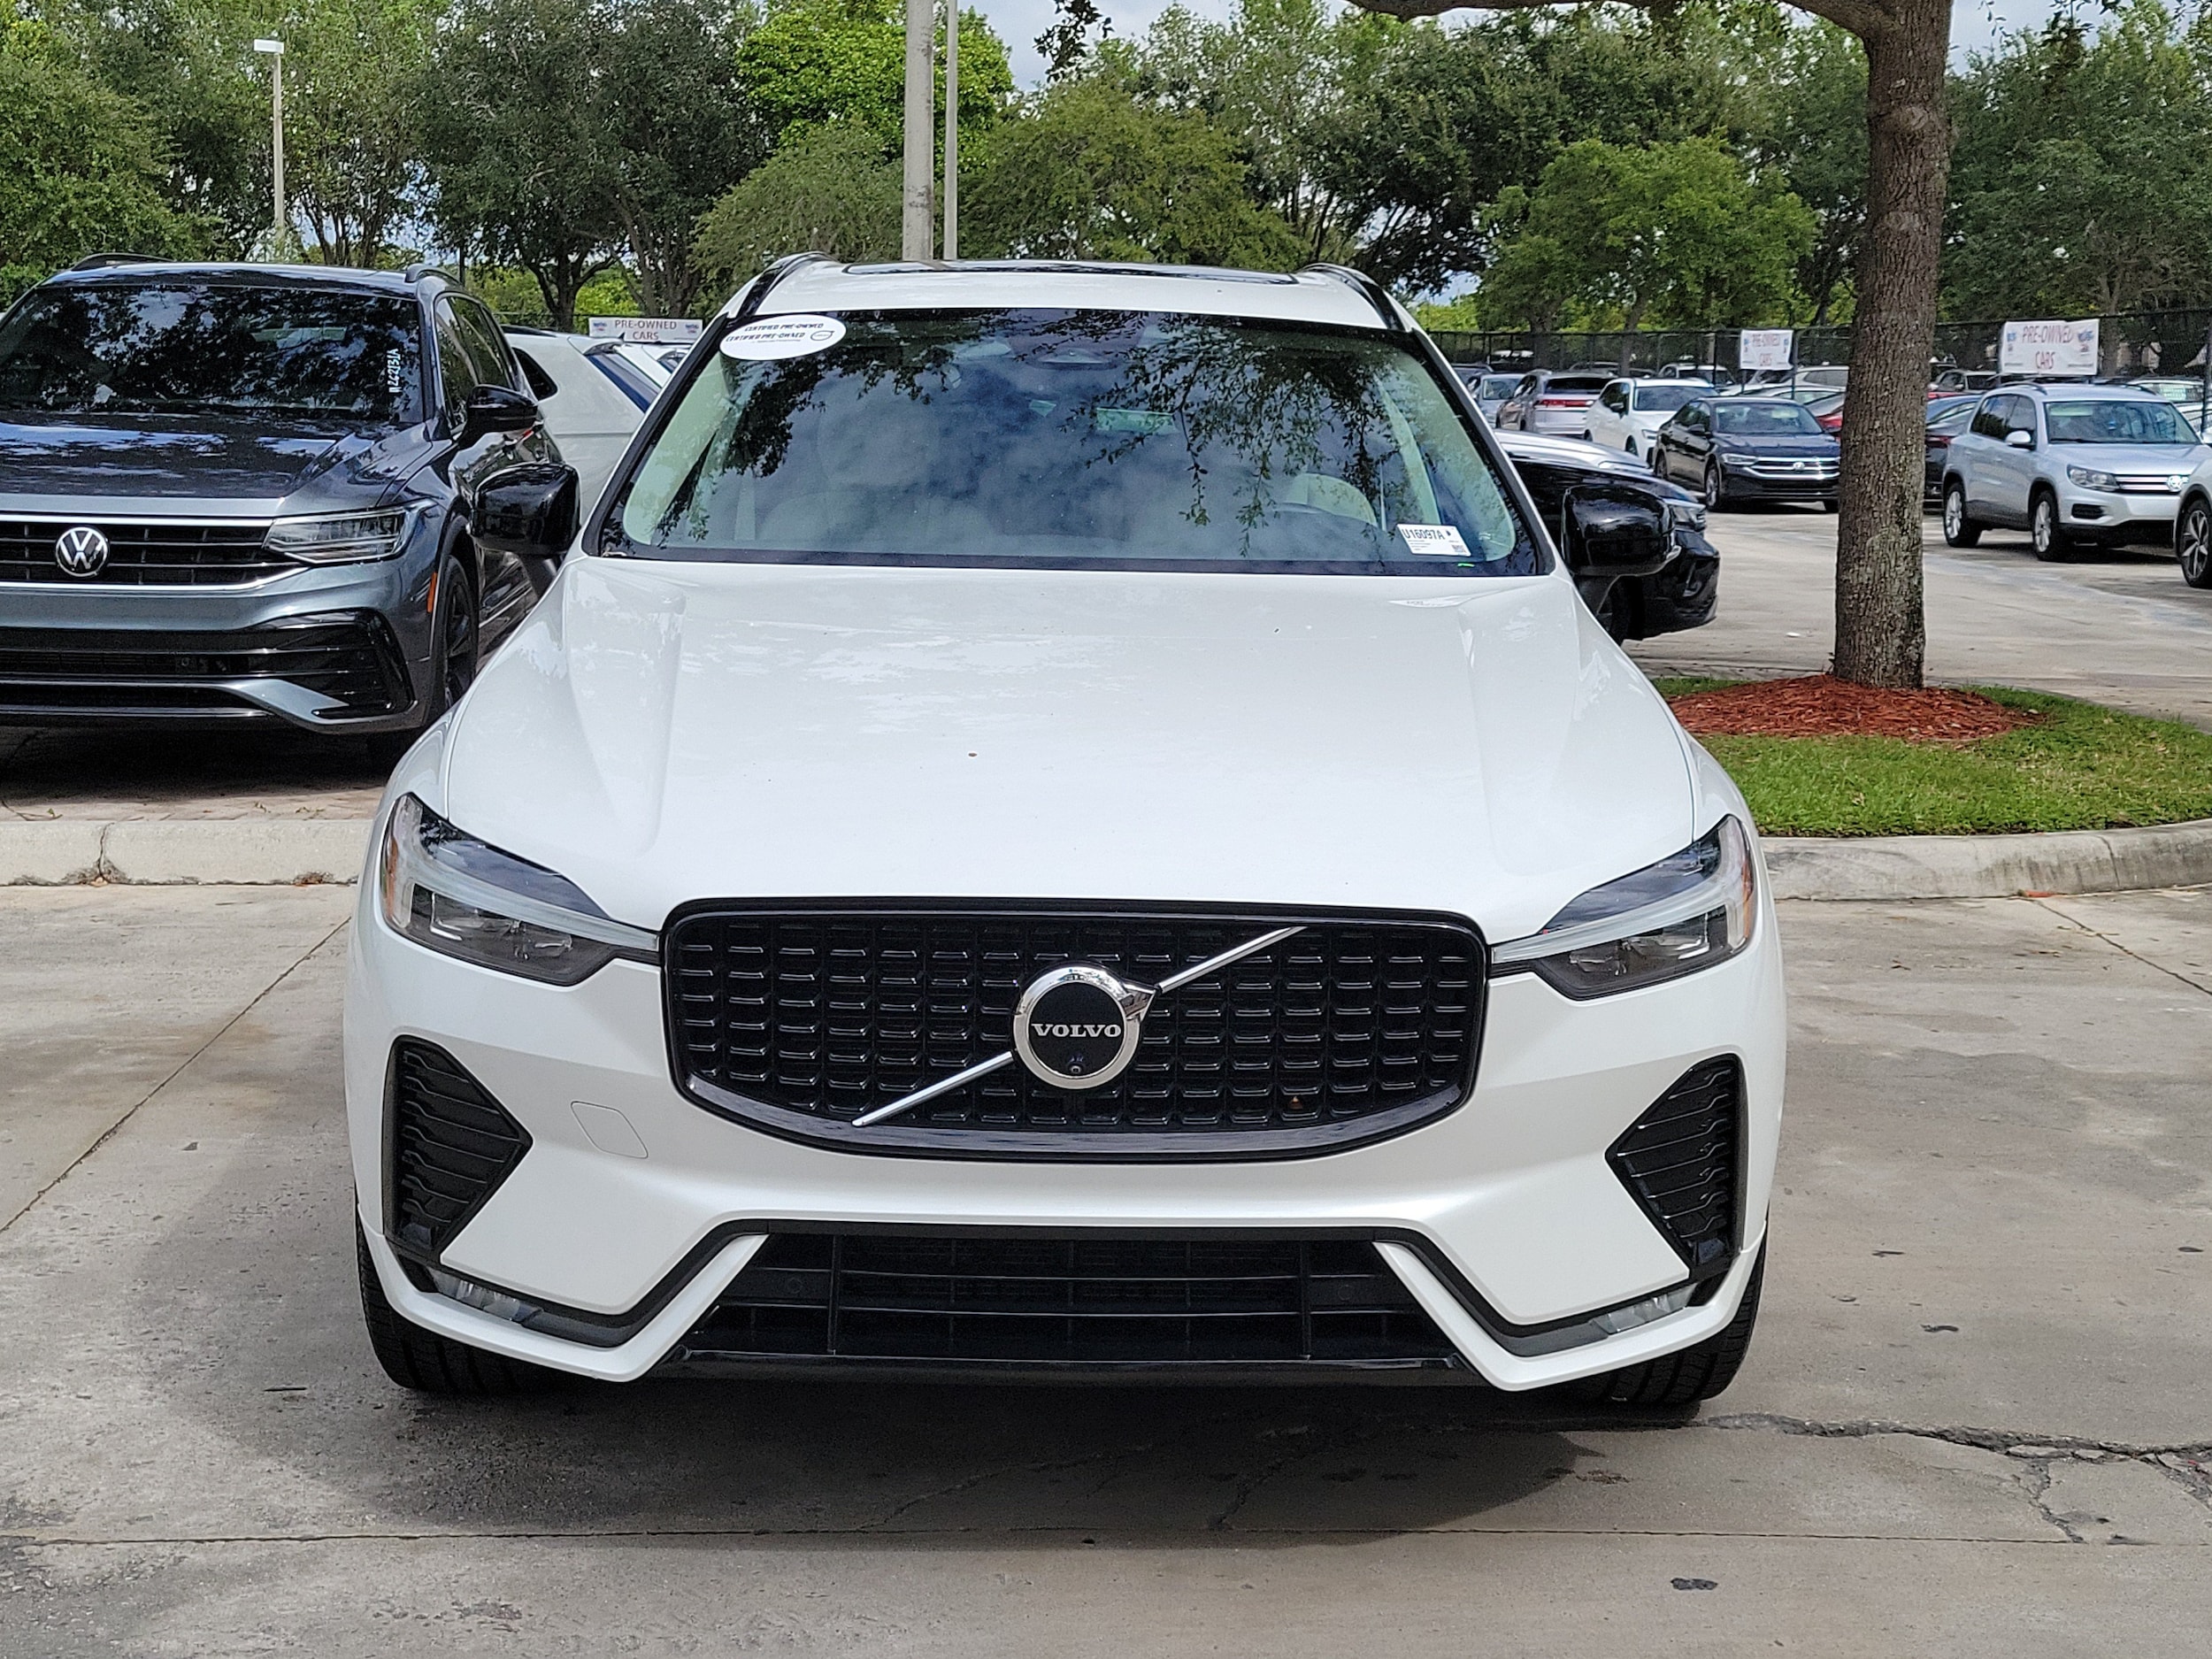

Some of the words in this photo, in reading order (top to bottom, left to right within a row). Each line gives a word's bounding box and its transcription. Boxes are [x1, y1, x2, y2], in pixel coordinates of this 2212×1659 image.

[614, 319, 677, 330] PRE-OWNED
[633, 331, 659, 341] CARS
[726, 334, 761, 342] CERTIFIED
[2021, 325, 2074, 344] PRE-OWNED
[2035, 350, 2055, 370] CARS
[1031, 1023, 1122, 1038] VOLVO
